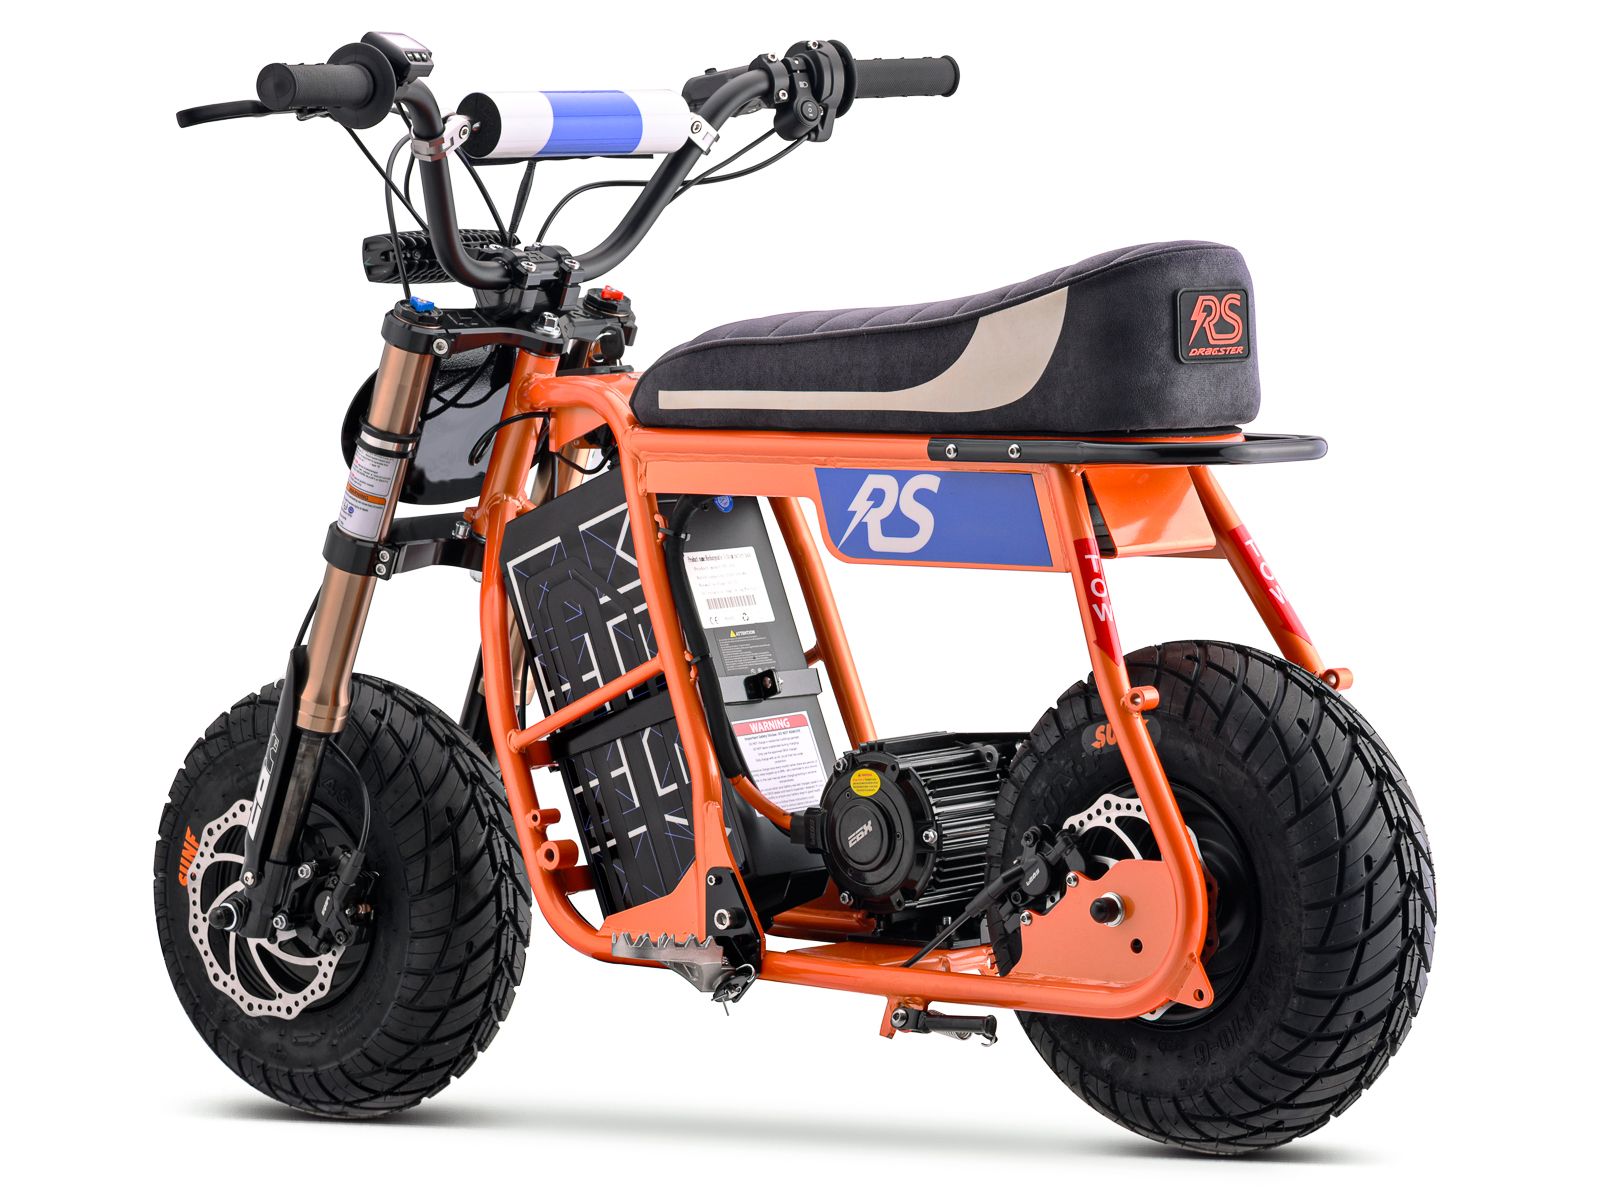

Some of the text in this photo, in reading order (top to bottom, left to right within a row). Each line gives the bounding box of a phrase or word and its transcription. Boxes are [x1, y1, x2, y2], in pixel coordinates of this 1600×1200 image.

[1189, 294, 1243, 346] RS
[1189, 346, 1244, 357] DRAGSTER
[837, 473, 941, 553] RS
[1084, 554, 1114, 622] TOW
[1245, 539, 1288, 605] TOW
[749, 718, 791, 733] WARNING
